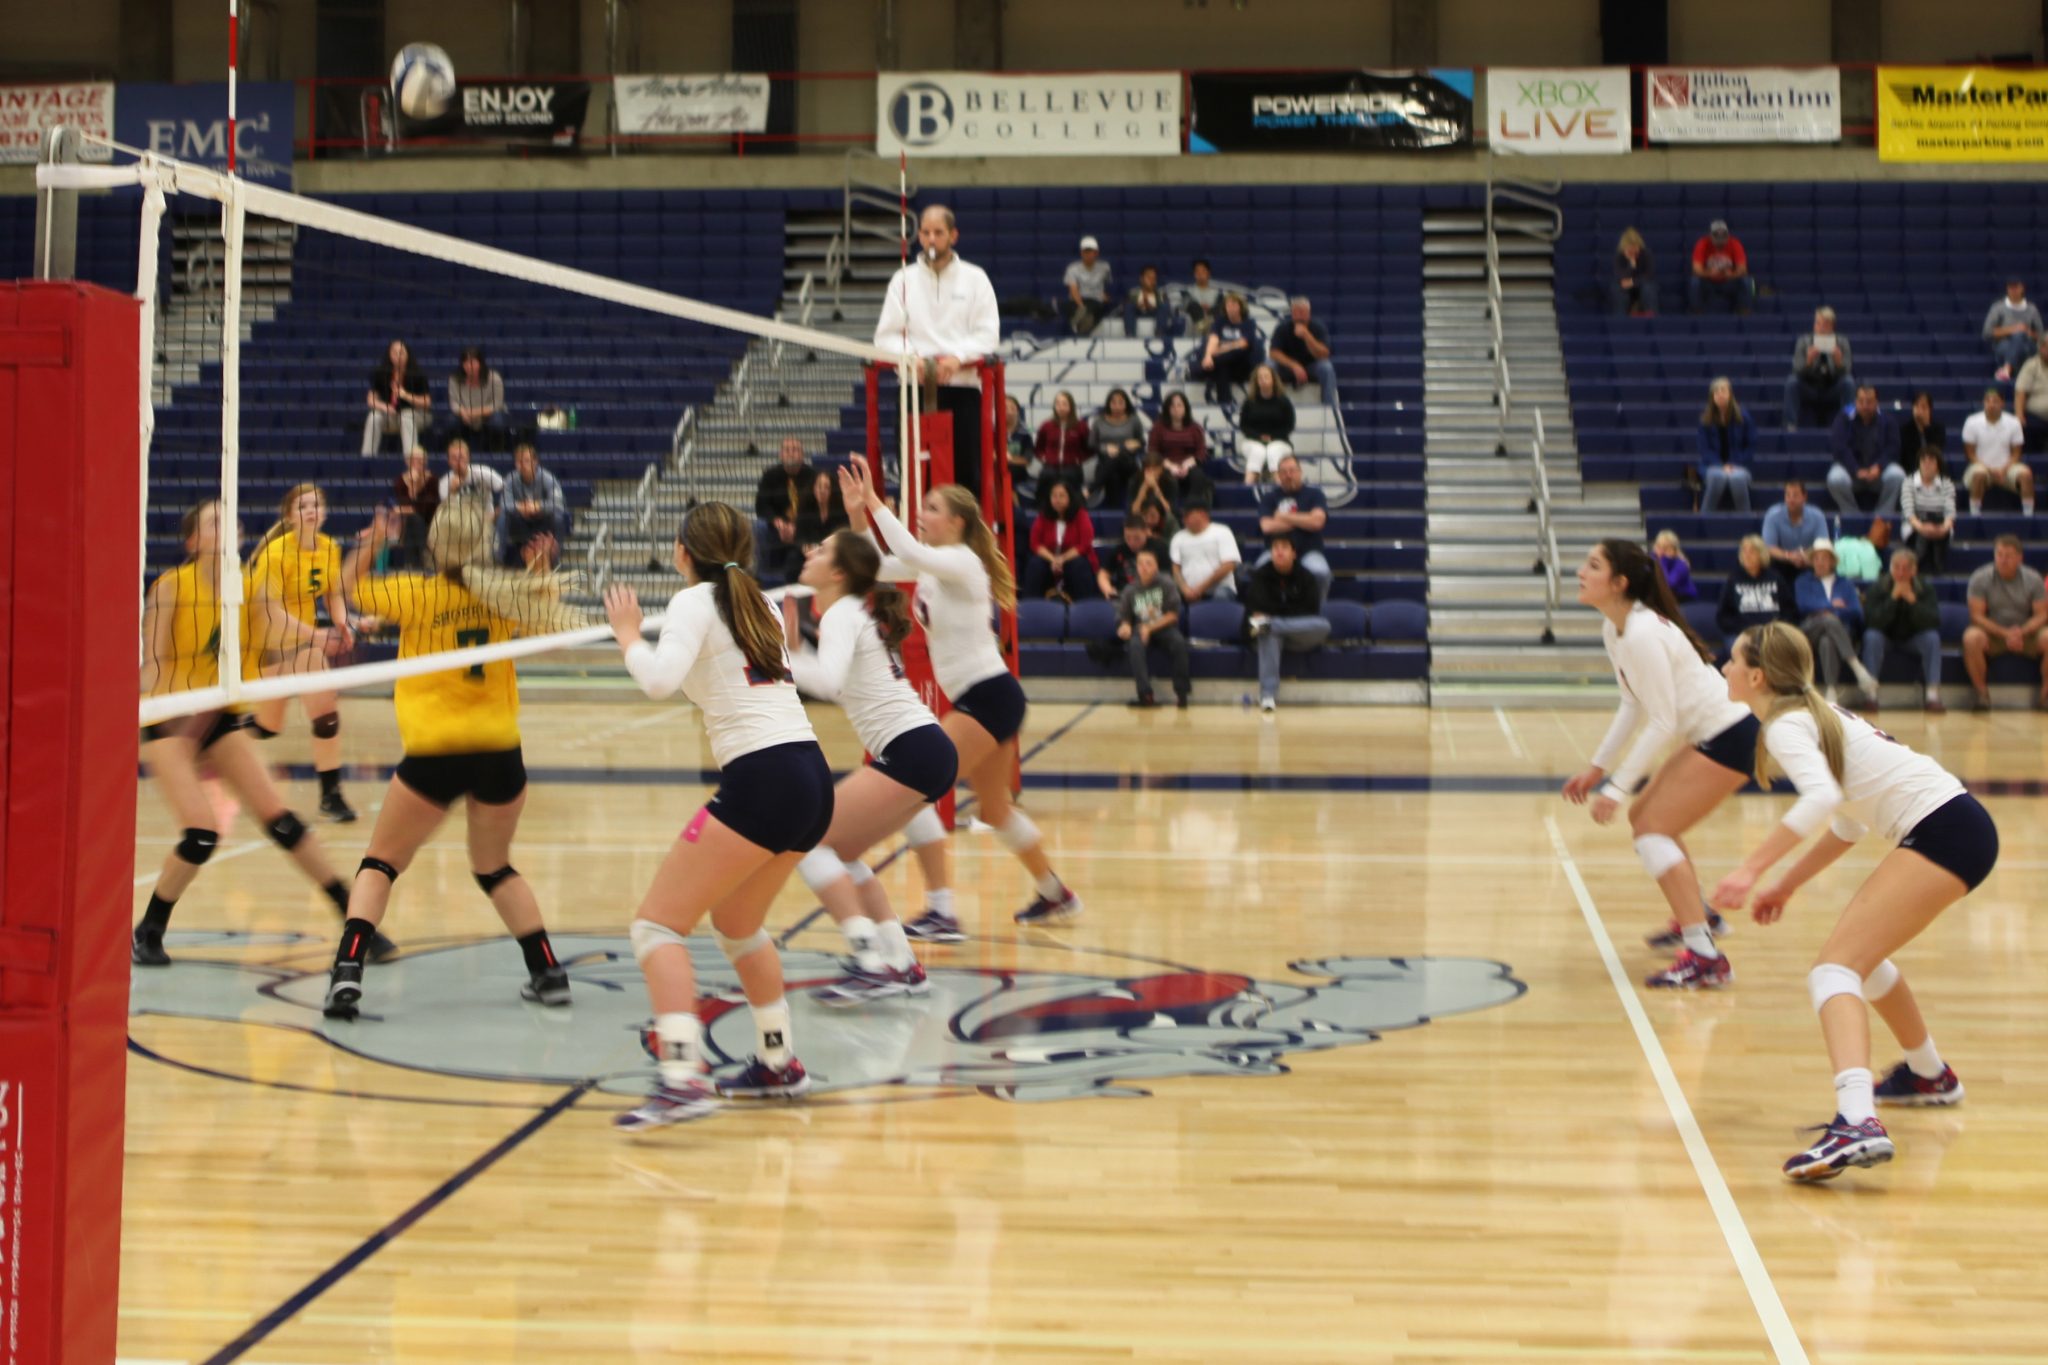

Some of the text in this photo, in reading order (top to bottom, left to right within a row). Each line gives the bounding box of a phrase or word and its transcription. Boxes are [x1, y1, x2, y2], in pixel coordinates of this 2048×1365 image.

[0, 88, 105, 108] NTAGE
[463, 86, 555, 112] ENJOY
[965, 89, 1172, 113] BELLEVUE
[1517, 79, 1601, 107] XBOX
[1691, 88, 1831, 108] Garden Inn
[964, 121, 1172, 139] COLLEGE
[1501, 110, 1618, 139] LIVE
[308, 568, 322, 594] 5
[456, 628, 490, 682] 7
